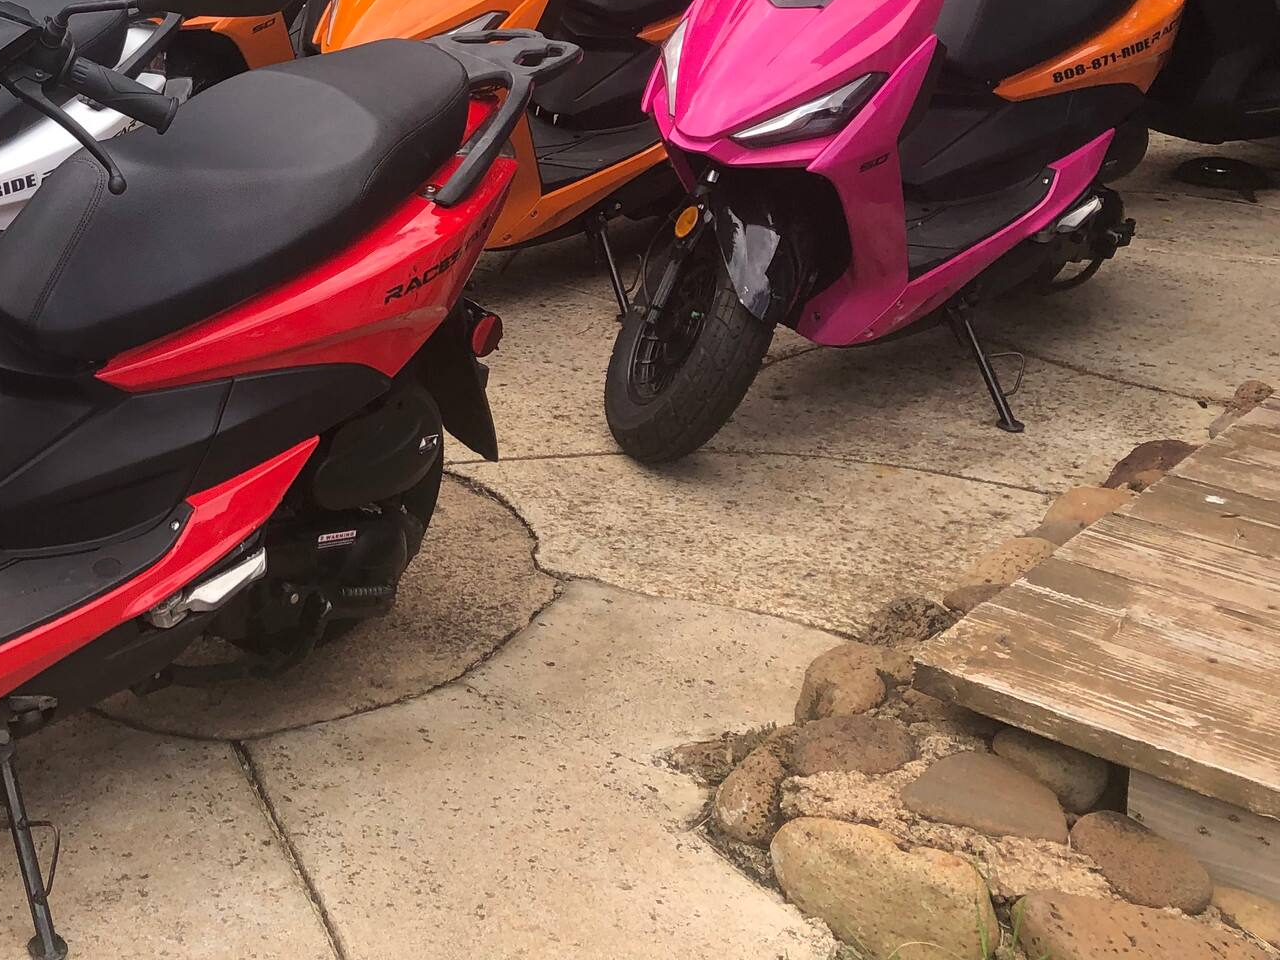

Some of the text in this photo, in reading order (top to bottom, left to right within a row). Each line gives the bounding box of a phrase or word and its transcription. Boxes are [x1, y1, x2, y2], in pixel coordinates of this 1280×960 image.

[252, 17, 276, 34] 50
[1052, 37, 1152, 84] 808-871-RIDE
[859, 151, 891, 173] 50
